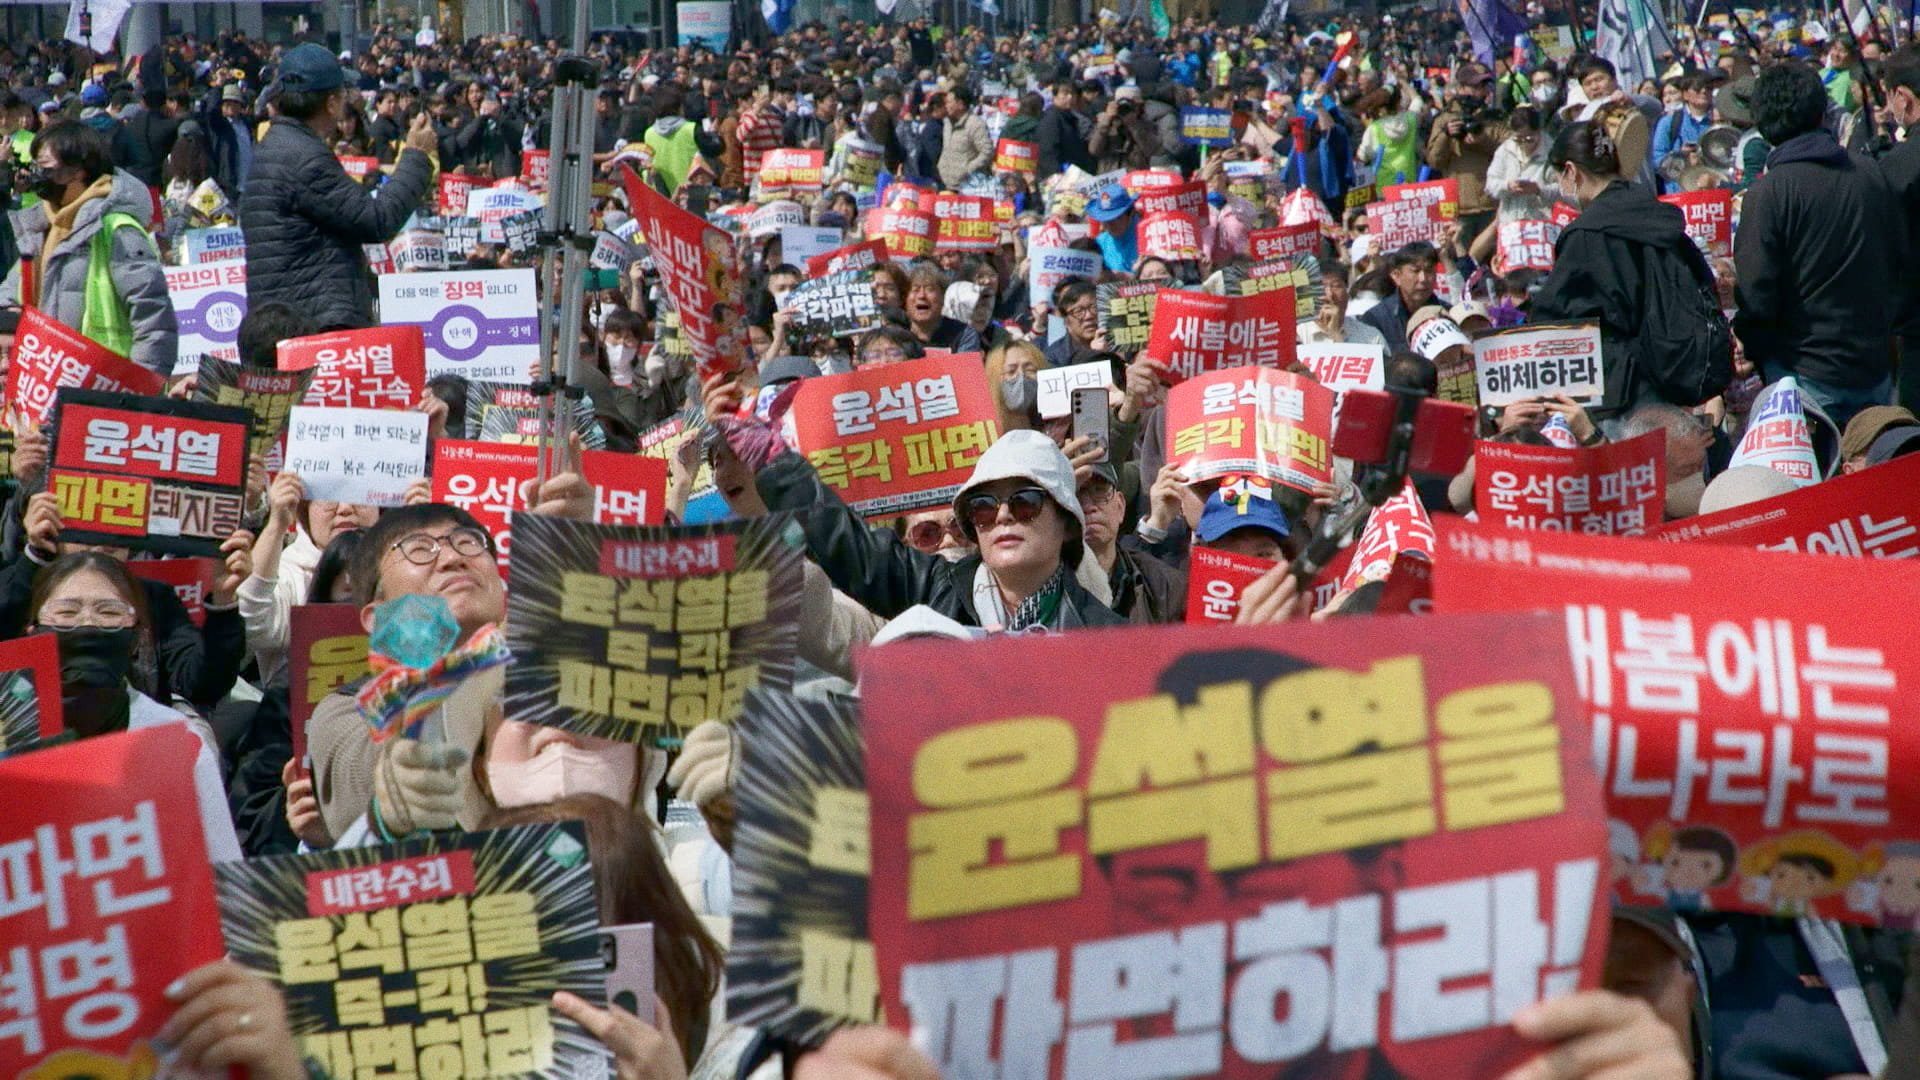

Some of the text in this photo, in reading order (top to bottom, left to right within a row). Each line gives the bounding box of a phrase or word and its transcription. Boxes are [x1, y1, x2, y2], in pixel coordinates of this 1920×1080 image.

[882, 214, 929, 235] 윤석열
[934, 201, 981, 218] 윤석열
[1691, 201, 1725, 222] 파면
[1255, 236, 1296, 256] 윤석열
[395, 287, 417, 299] 다음
[508, 325, 531, 338] 징역
[1169, 316, 1281, 352] 새봄에는
[15, 333, 92, 389] 윤석열
[314, 344, 396, 377] 윤석열
[1303, 354, 1376, 386] 세력
[1485, 356, 1599, 394] 해체하라
[358, 377, 413, 407] 구속
[501, 390, 541, 406] 내란수
[831, 373, 962, 437] 윤석열
[1202, 379, 1305, 422] 윤석열
[83, 418, 222, 477] 윤석열
[1174, 416, 1246, 457] 즉각
[807, 437, 894, 490] 즉각
[55, 473, 149, 528] 파면
[1488, 458, 1657, 514] 윤석열 파면
[560, 567, 770, 634] 윤석열을
[906, 652, 1566, 923] 윤석열을
[0, 799, 172, 930] 파면
[274, 889, 542, 987] 윤석열을
[899, 856, 1600, 1080] 파면하라!
